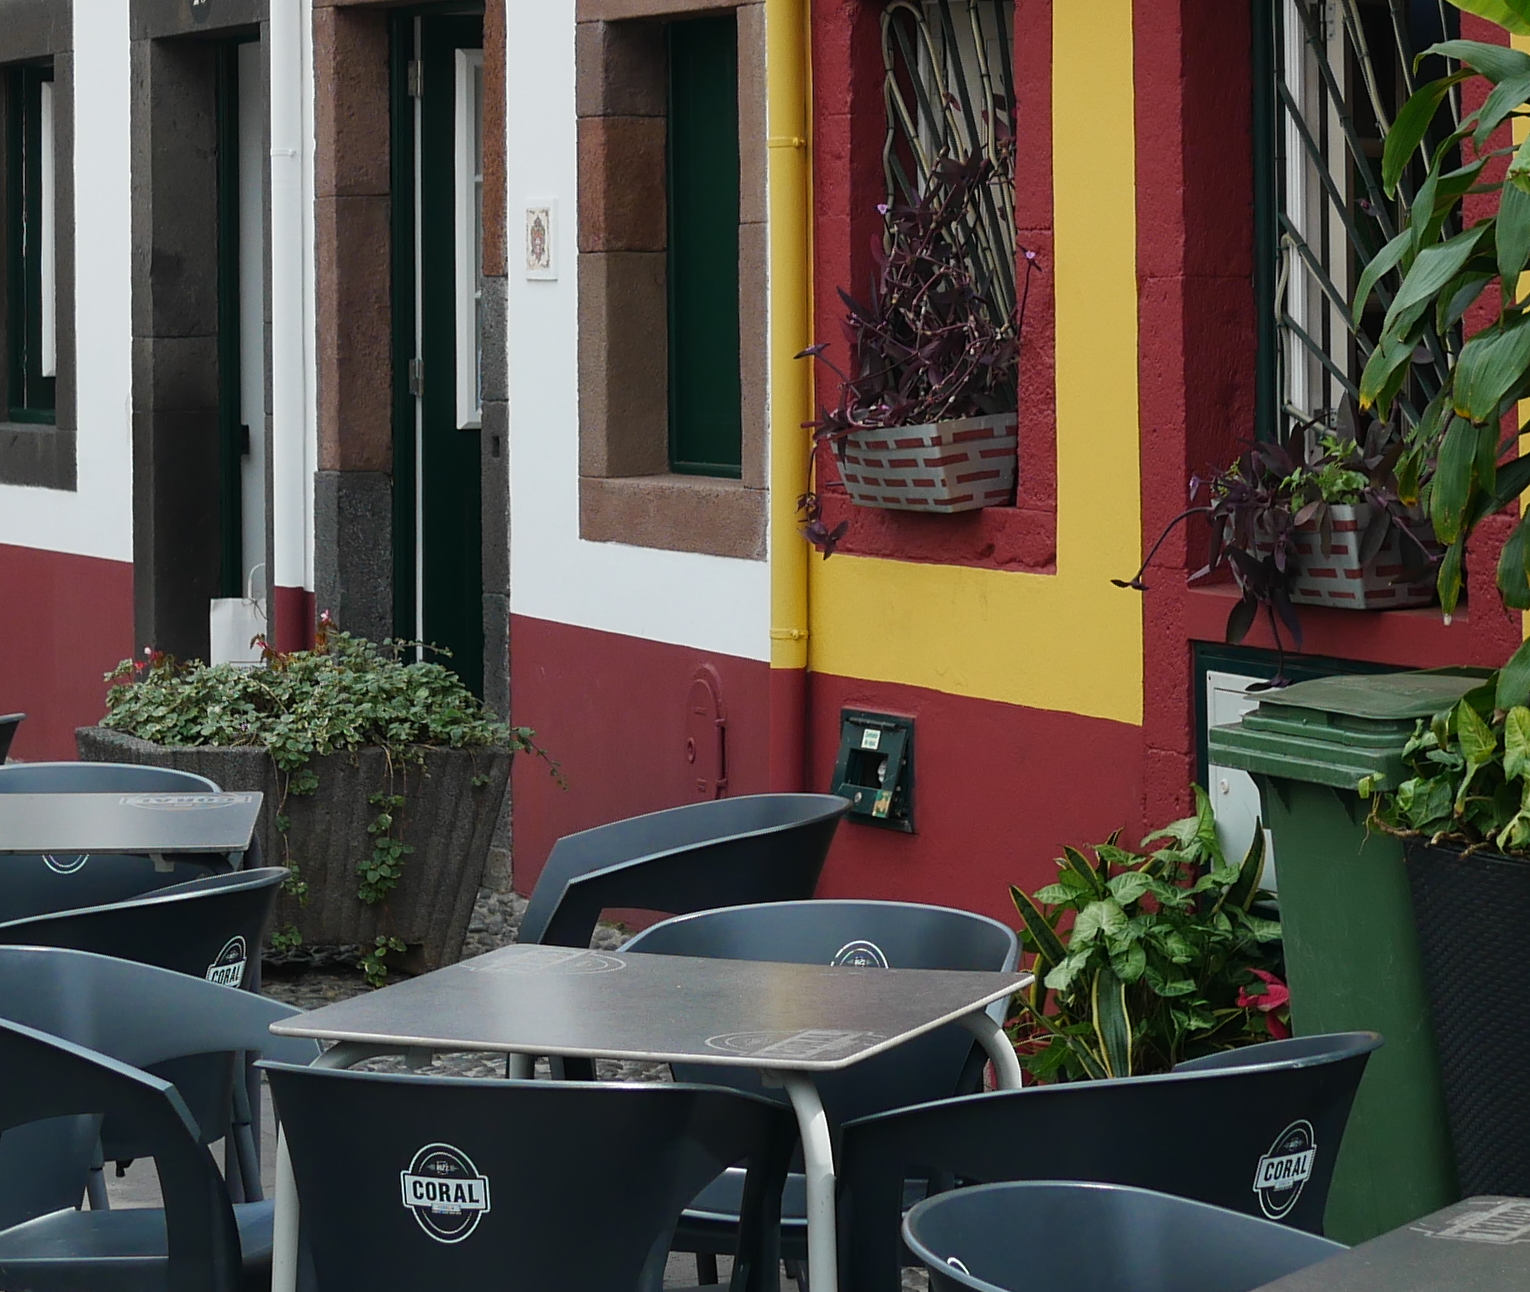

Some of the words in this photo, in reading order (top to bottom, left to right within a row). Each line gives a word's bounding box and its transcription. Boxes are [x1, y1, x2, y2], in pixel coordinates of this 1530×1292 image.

[211, 965, 241, 985] CORAL
[1263, 1155, 1307, 1182] CORAL
[412, 1180, 480, 1204] CORAL
